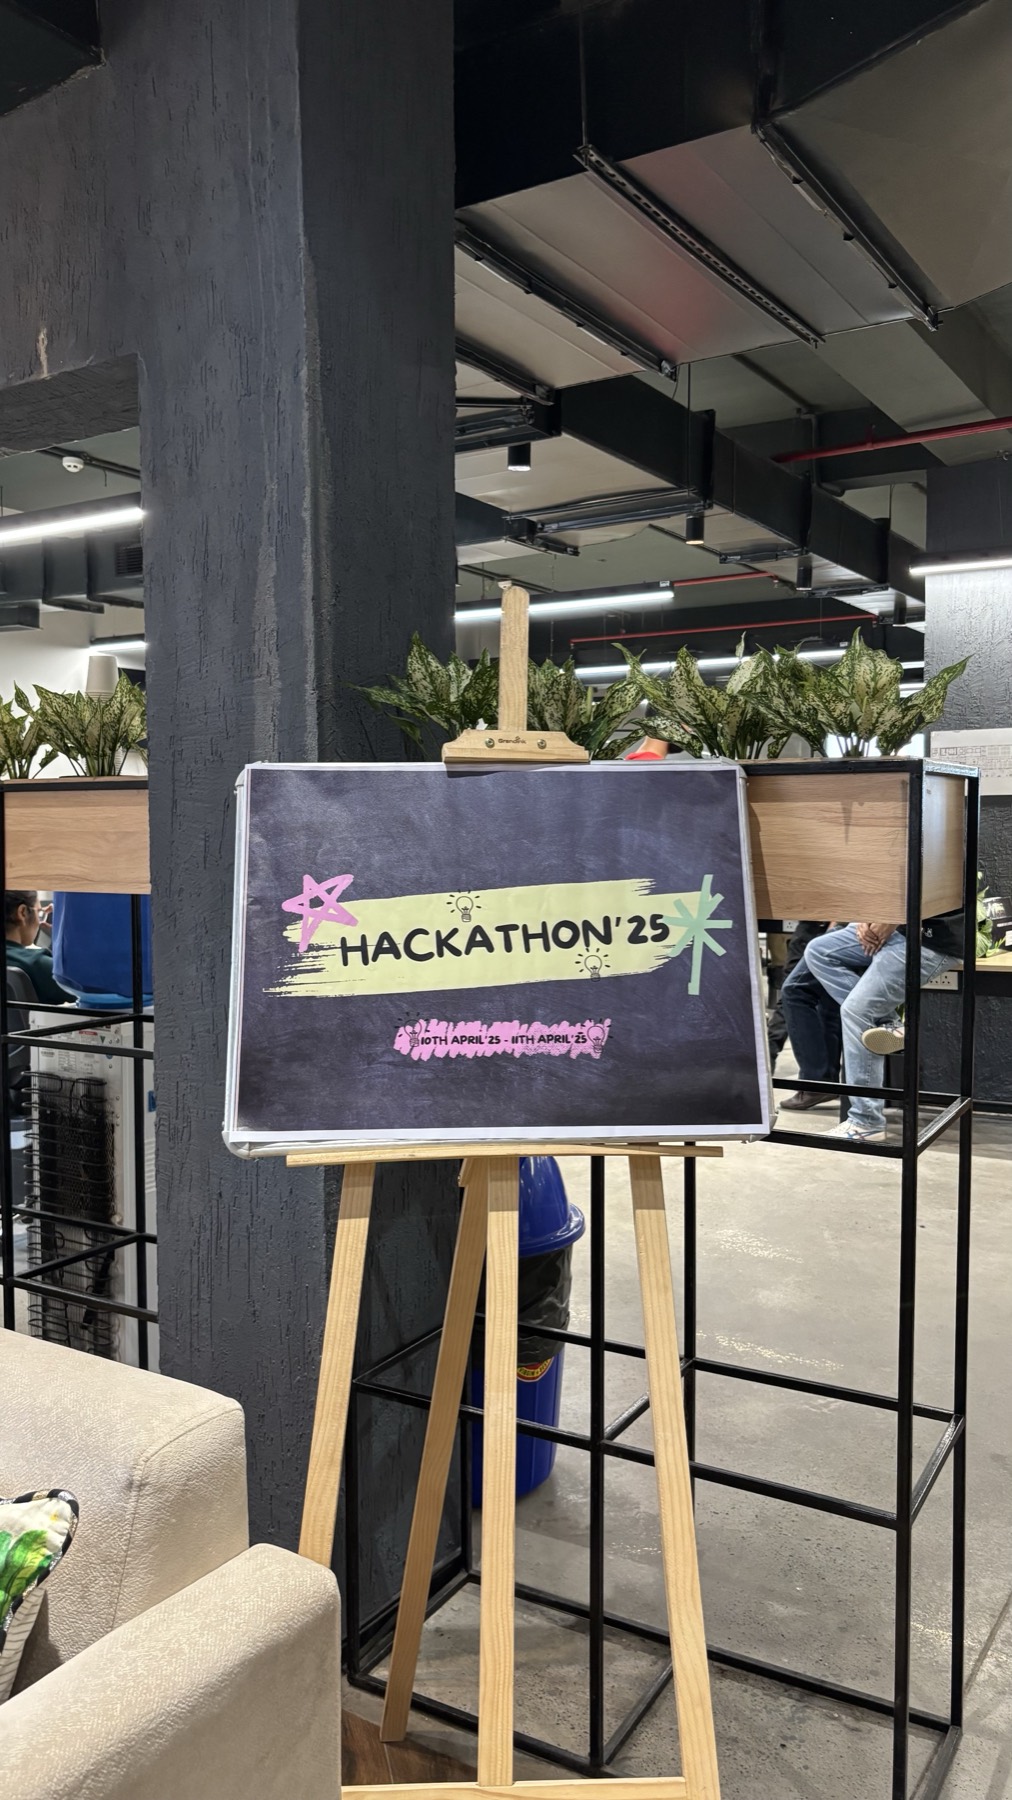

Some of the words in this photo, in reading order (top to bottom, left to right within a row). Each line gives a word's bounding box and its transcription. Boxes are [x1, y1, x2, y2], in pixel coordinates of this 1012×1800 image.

[340, 914, 670, 966] HACKATHON'25
[421, 1036, 448, 1046] 10TH
[451, 1035, 500, 1045] APRIL'25
[511, 1035, 534, 1045] 11TH
[537, 1034, 587, 1045] APRIL'25
